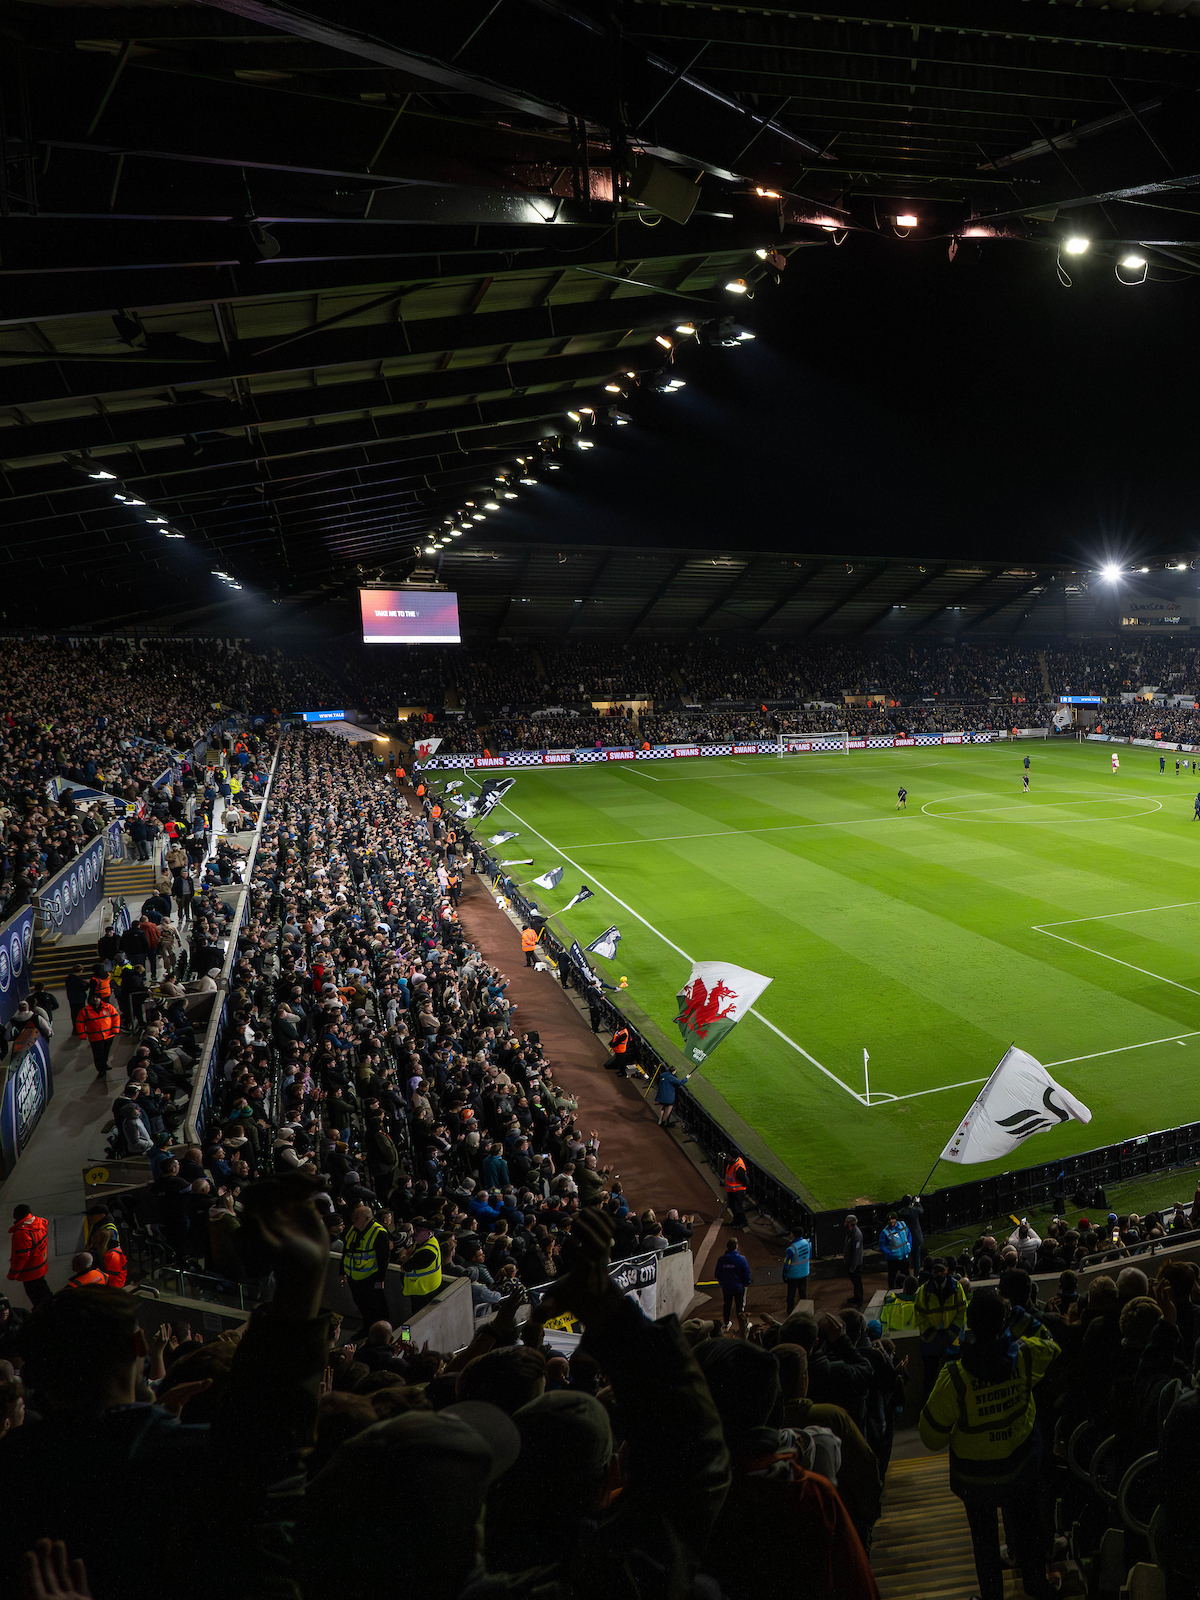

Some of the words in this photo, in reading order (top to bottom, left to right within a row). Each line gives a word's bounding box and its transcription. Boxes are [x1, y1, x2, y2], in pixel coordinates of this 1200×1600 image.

[895, 737, 915, 746] SWANS
[943, 735, 962, 744] SWANS
[676, 748, 699, 757] SWANS
[733, 745, 757, 754] SWANS
[544, 754, 571, 764] SWANS
[609, 751, 635, 760] SWANS
[476, 757, 505, 767] SWANS
